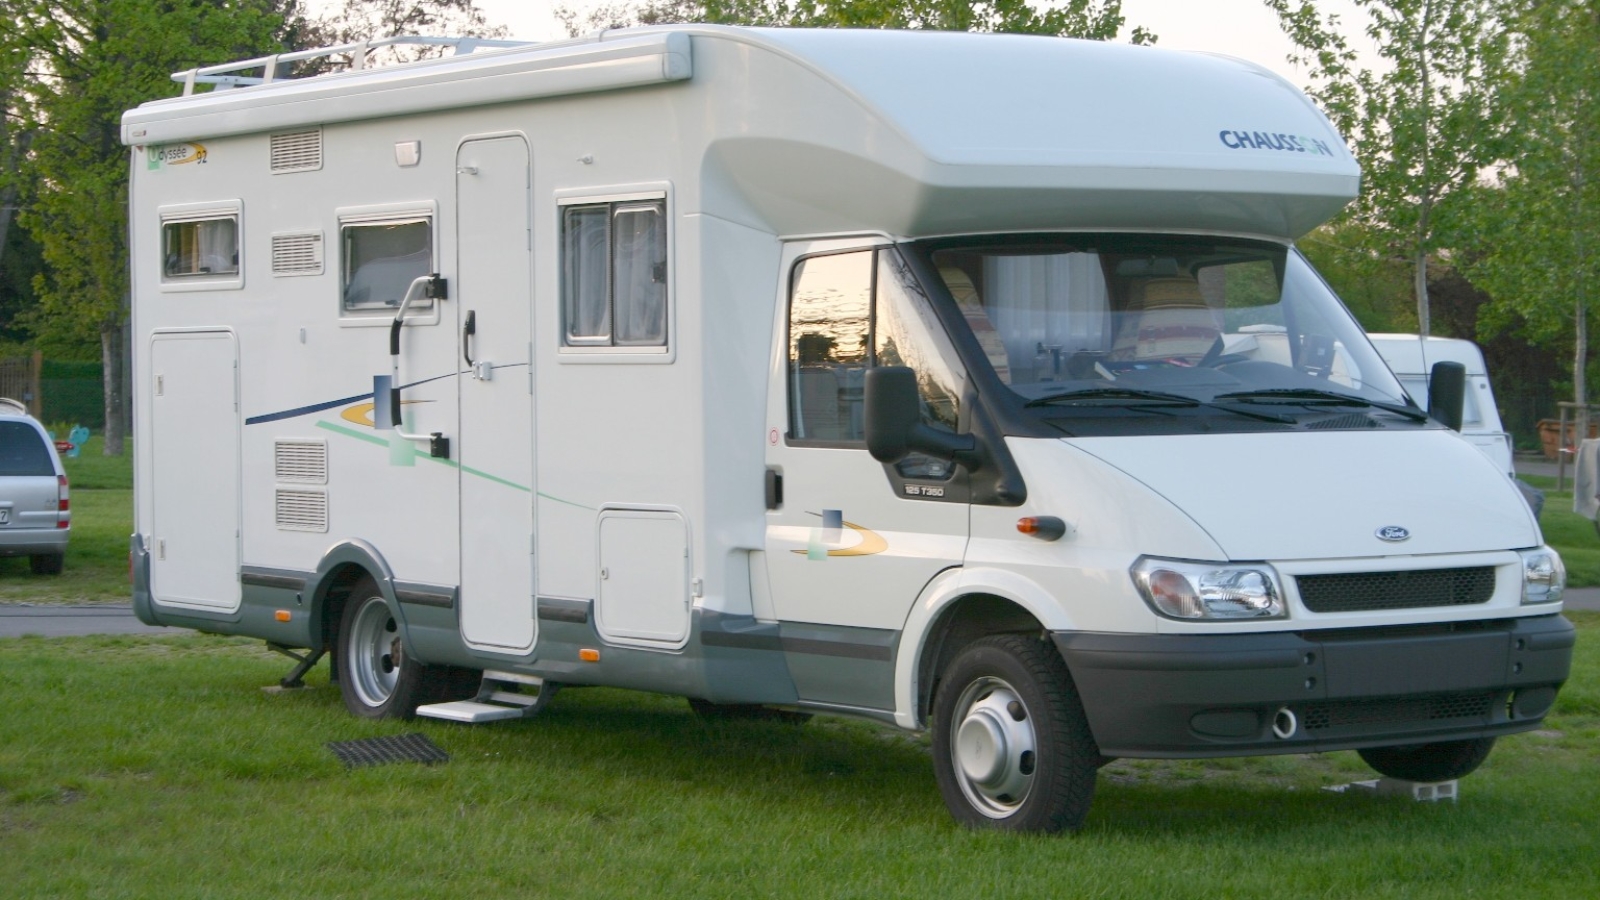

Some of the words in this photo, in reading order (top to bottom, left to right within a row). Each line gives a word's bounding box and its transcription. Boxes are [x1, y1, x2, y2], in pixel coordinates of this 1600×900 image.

[1219, 129, 1334, 157] CHAUSSON
[197, 150, 208, 164] 92
[905, 486, 920, 495] 125
